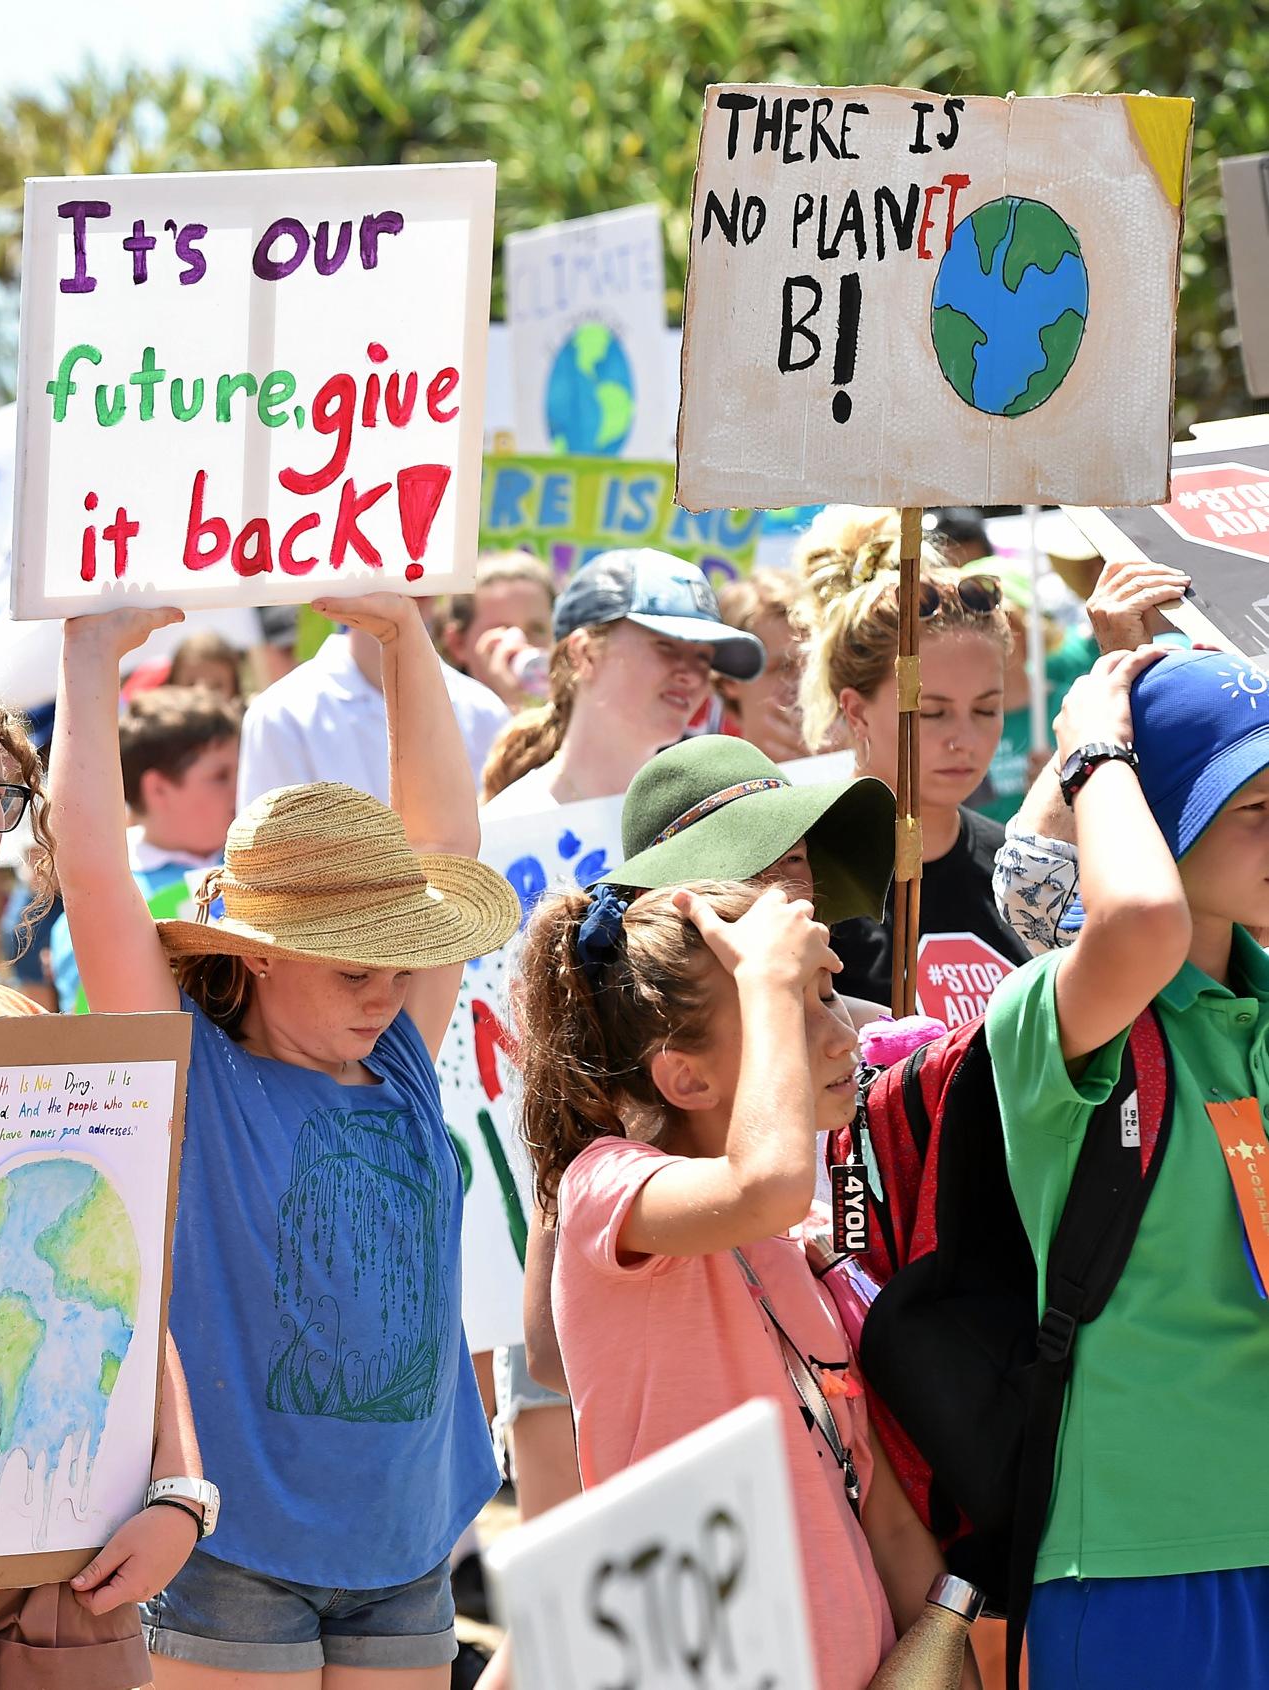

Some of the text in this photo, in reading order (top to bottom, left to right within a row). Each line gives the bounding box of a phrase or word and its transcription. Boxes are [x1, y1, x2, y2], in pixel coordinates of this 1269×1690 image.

[716, 93, 965, 164] THERE IS
[57, 200, 404, 294] It's our
[701, 173, 971, 262] NO PLANET
[777, 272, 862, 425] B!
[46, 342, 460, 495] future, give
[80, 491, 139, 582] it
[603, 477, 657, 534] IS
[19, 1101, 41, 1118] And
[48, 1096, 62, 1114] the
[67, 1099, 98, 1118] people
[104, 1096, 122, 1110] who
[131, 1100, 149, 1109] are
[20, 1074, 29, 1093] Is
[34, 1074, 52, 1092] Not
[64, 1071, 94, 1096] Dying.
[107, 1070, 117, 1086] It
[122, 1070, 131, 1086] Is
[0, 1128, 23, 1140] have
[30, 1129, 56, 1139] names
[844, 1176, 865, 1249] 4YOU
